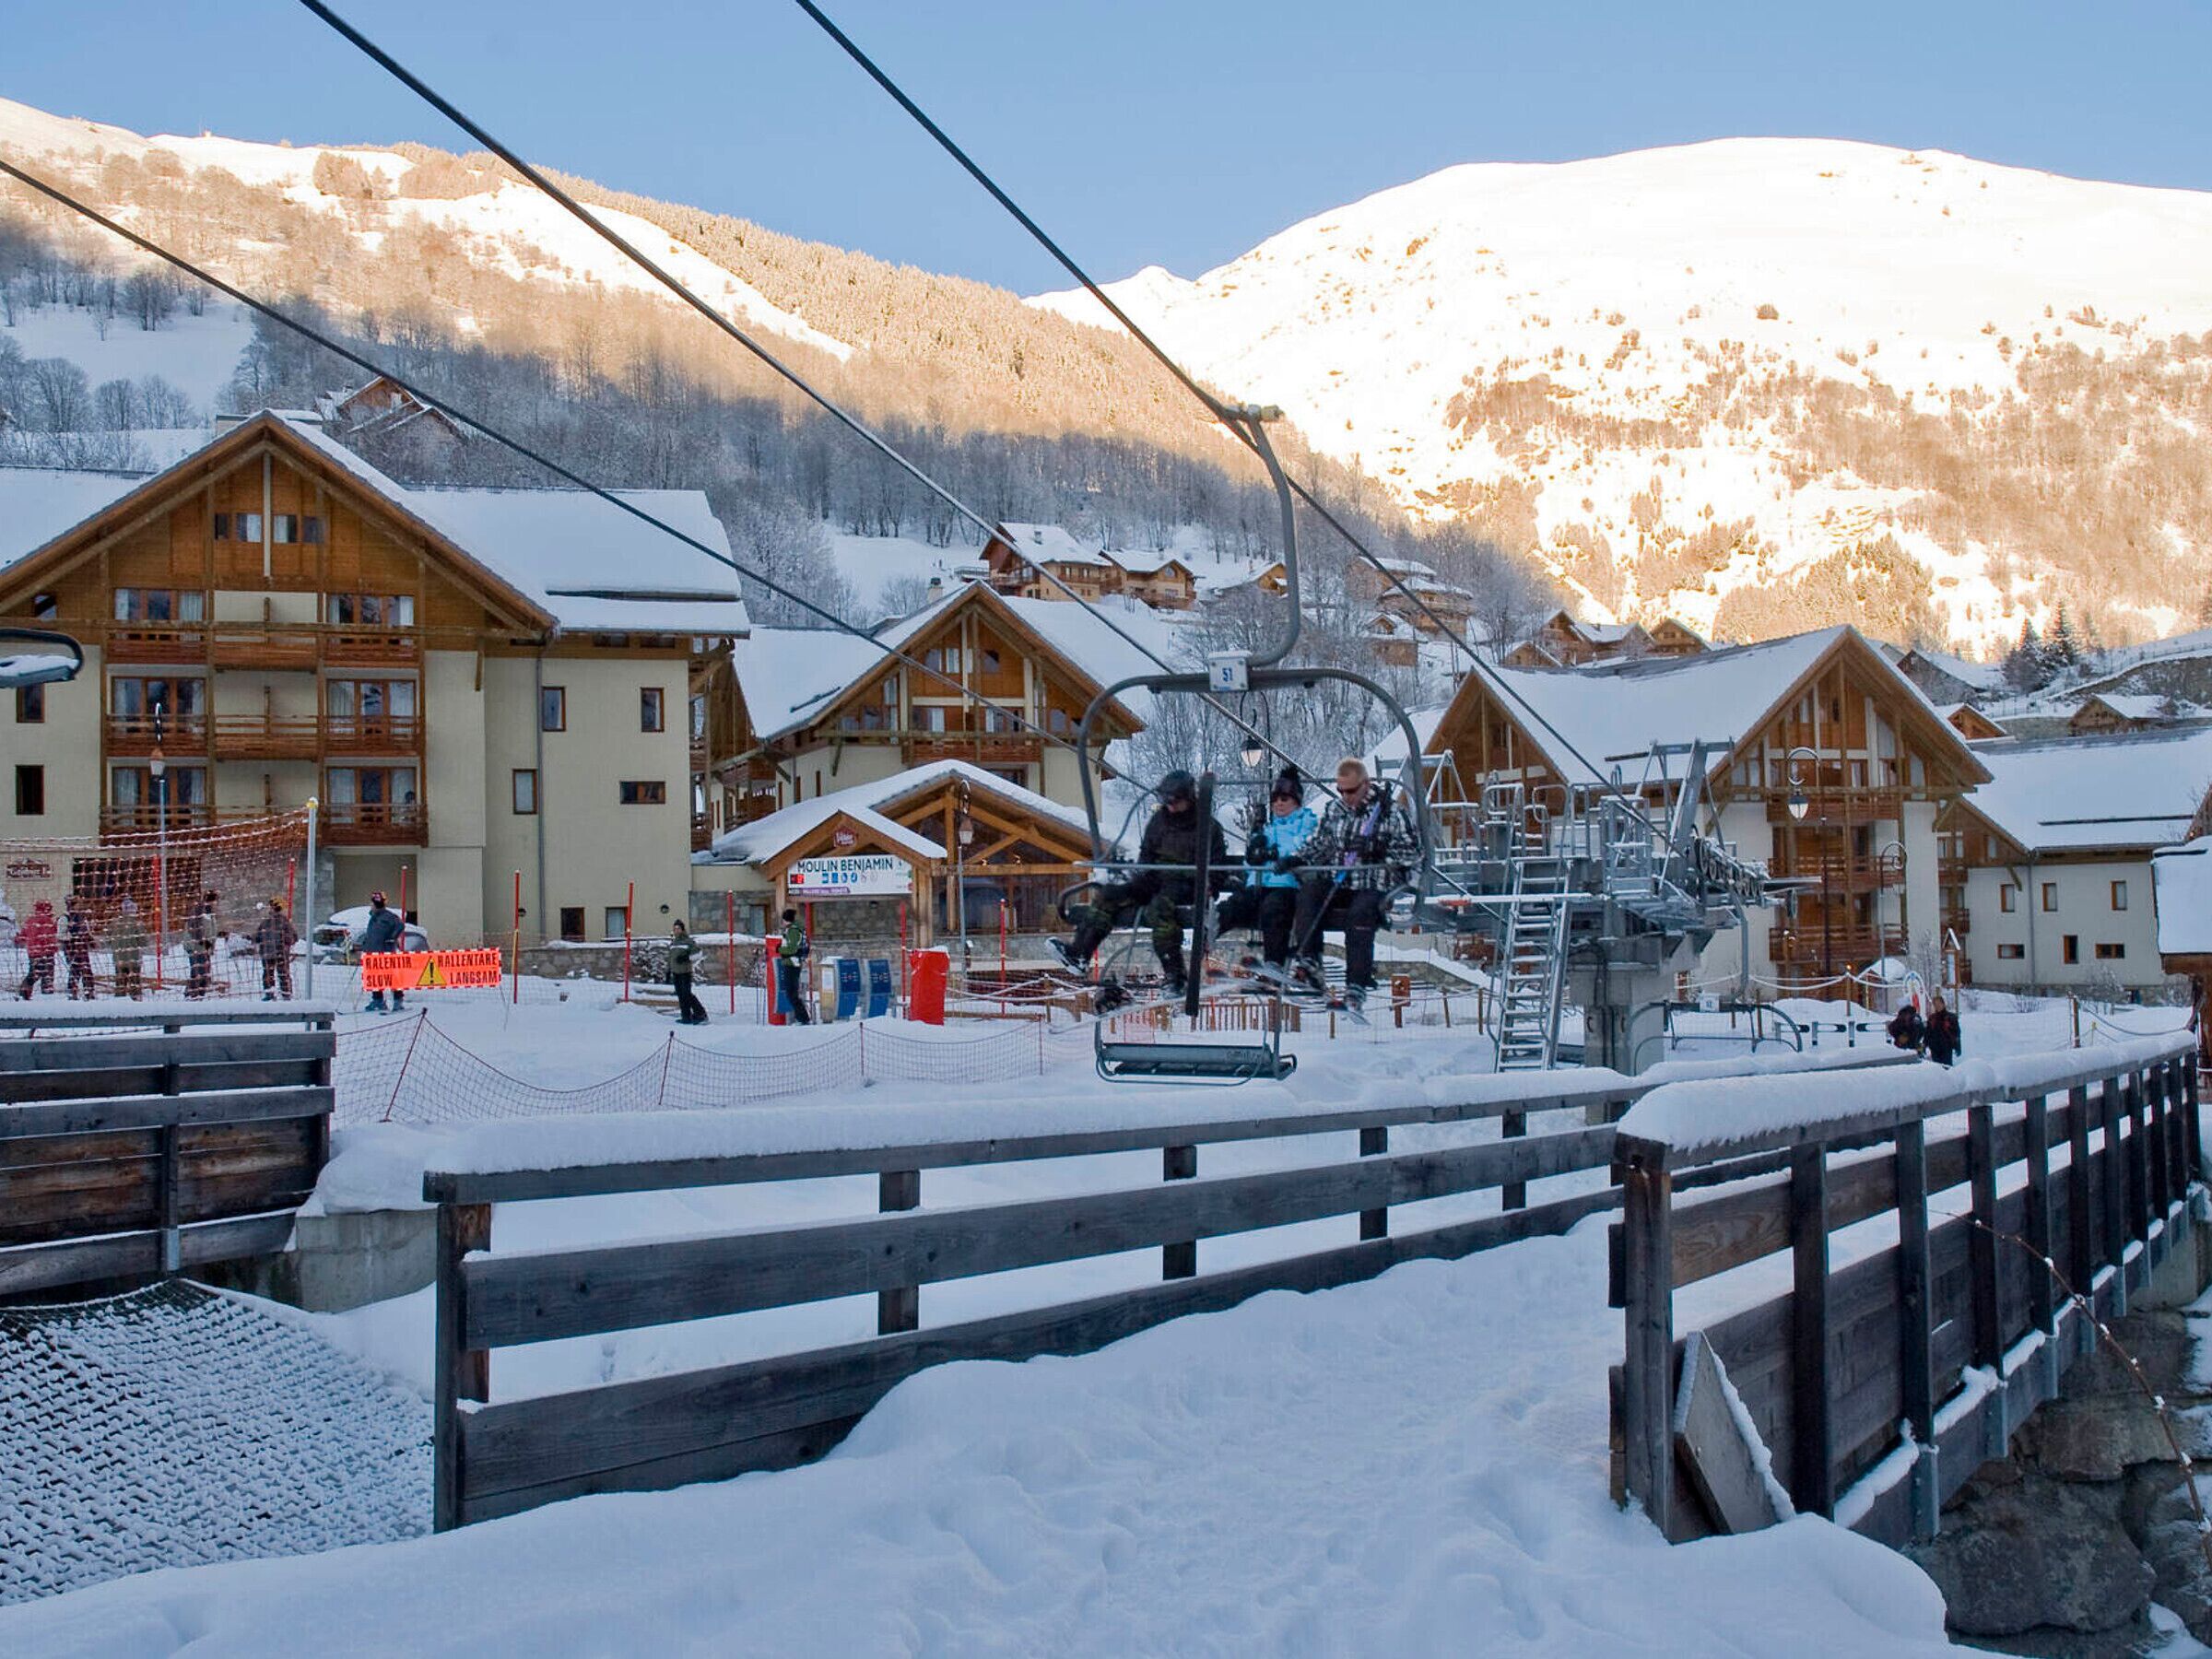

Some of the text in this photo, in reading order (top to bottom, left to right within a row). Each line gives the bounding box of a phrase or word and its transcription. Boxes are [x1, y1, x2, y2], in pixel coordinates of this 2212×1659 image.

[1222, 667, 1233, 682] 51
[797, 858, 893, 872] MOULIN BENJAMIN
[365, 957, 411, 970] RALENTIR
[437, 952, 497, 967] RALLENTARE
[366, 974, 393, 987] SLOW
[450, 971, 497, 984] LANGSAM
